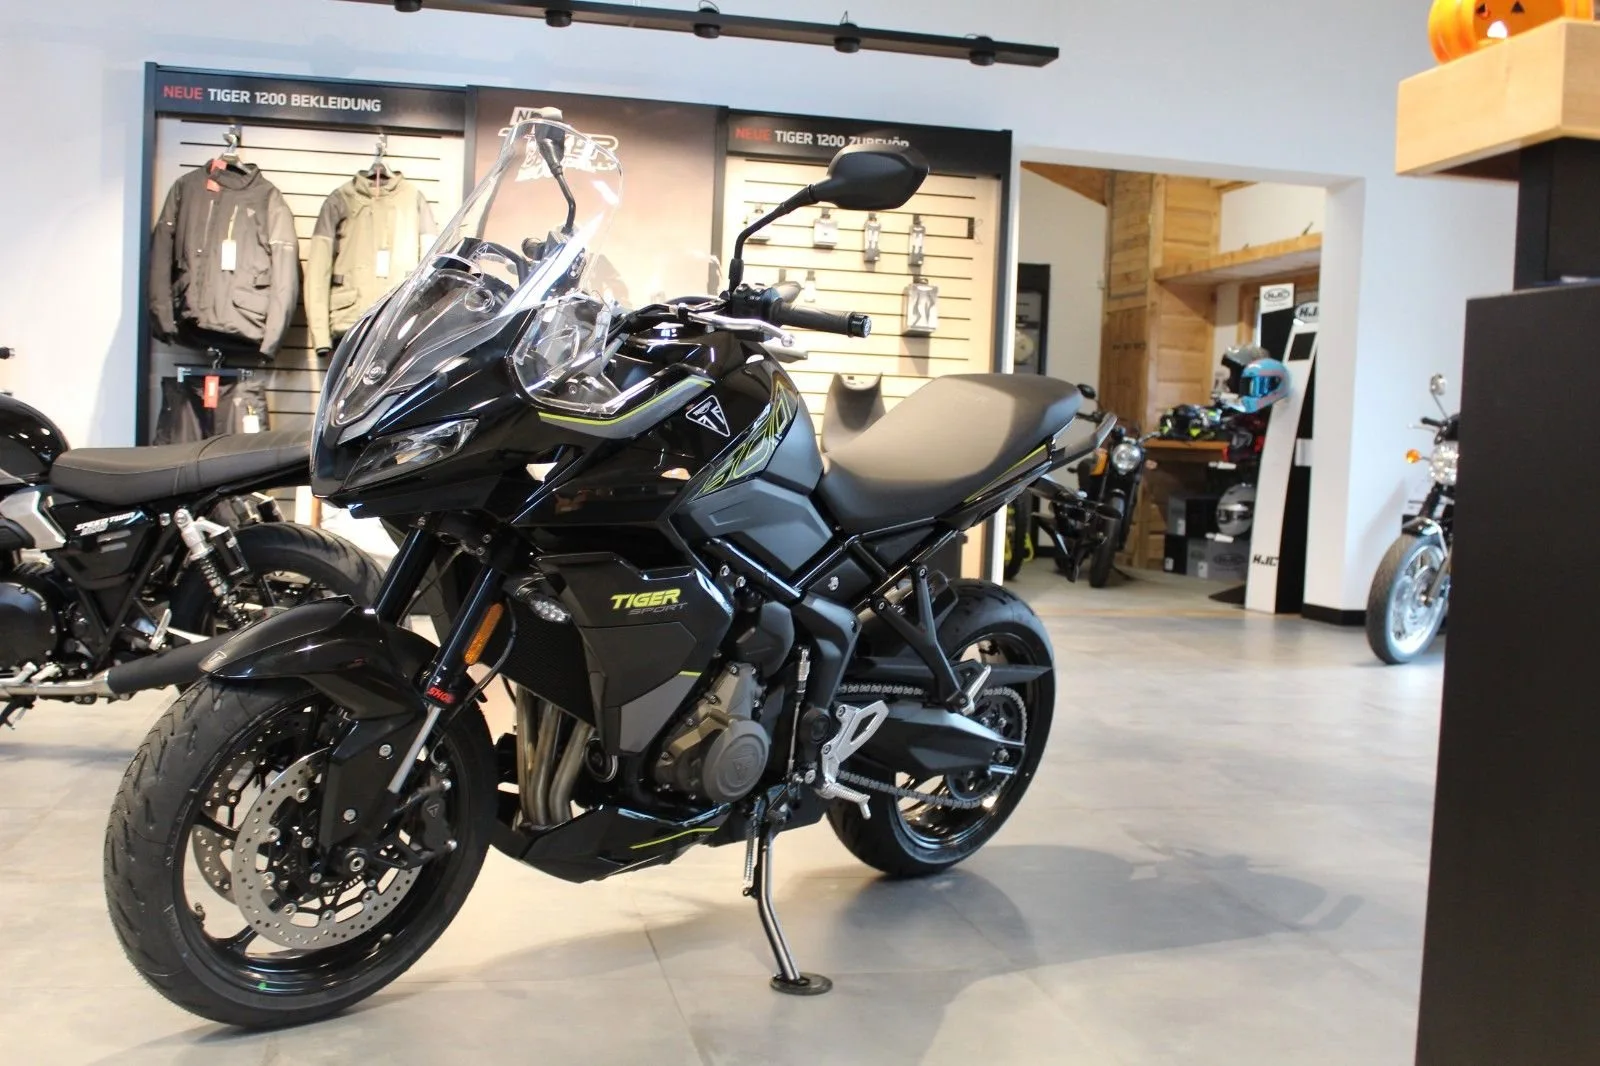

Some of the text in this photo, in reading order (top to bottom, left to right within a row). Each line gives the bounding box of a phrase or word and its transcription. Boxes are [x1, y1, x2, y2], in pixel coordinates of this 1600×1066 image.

[164, 87, 382, 112] NEUE TIGER 1200 BEKLEIDUNG
[736, 128, 770, 142] NEUE
[775, 131, 813, 145] TIGER
[816, 133, 846, 148] 1200
[610, 588, 681, 610] TIGER
[628, 602, 688, 616] SPORT
